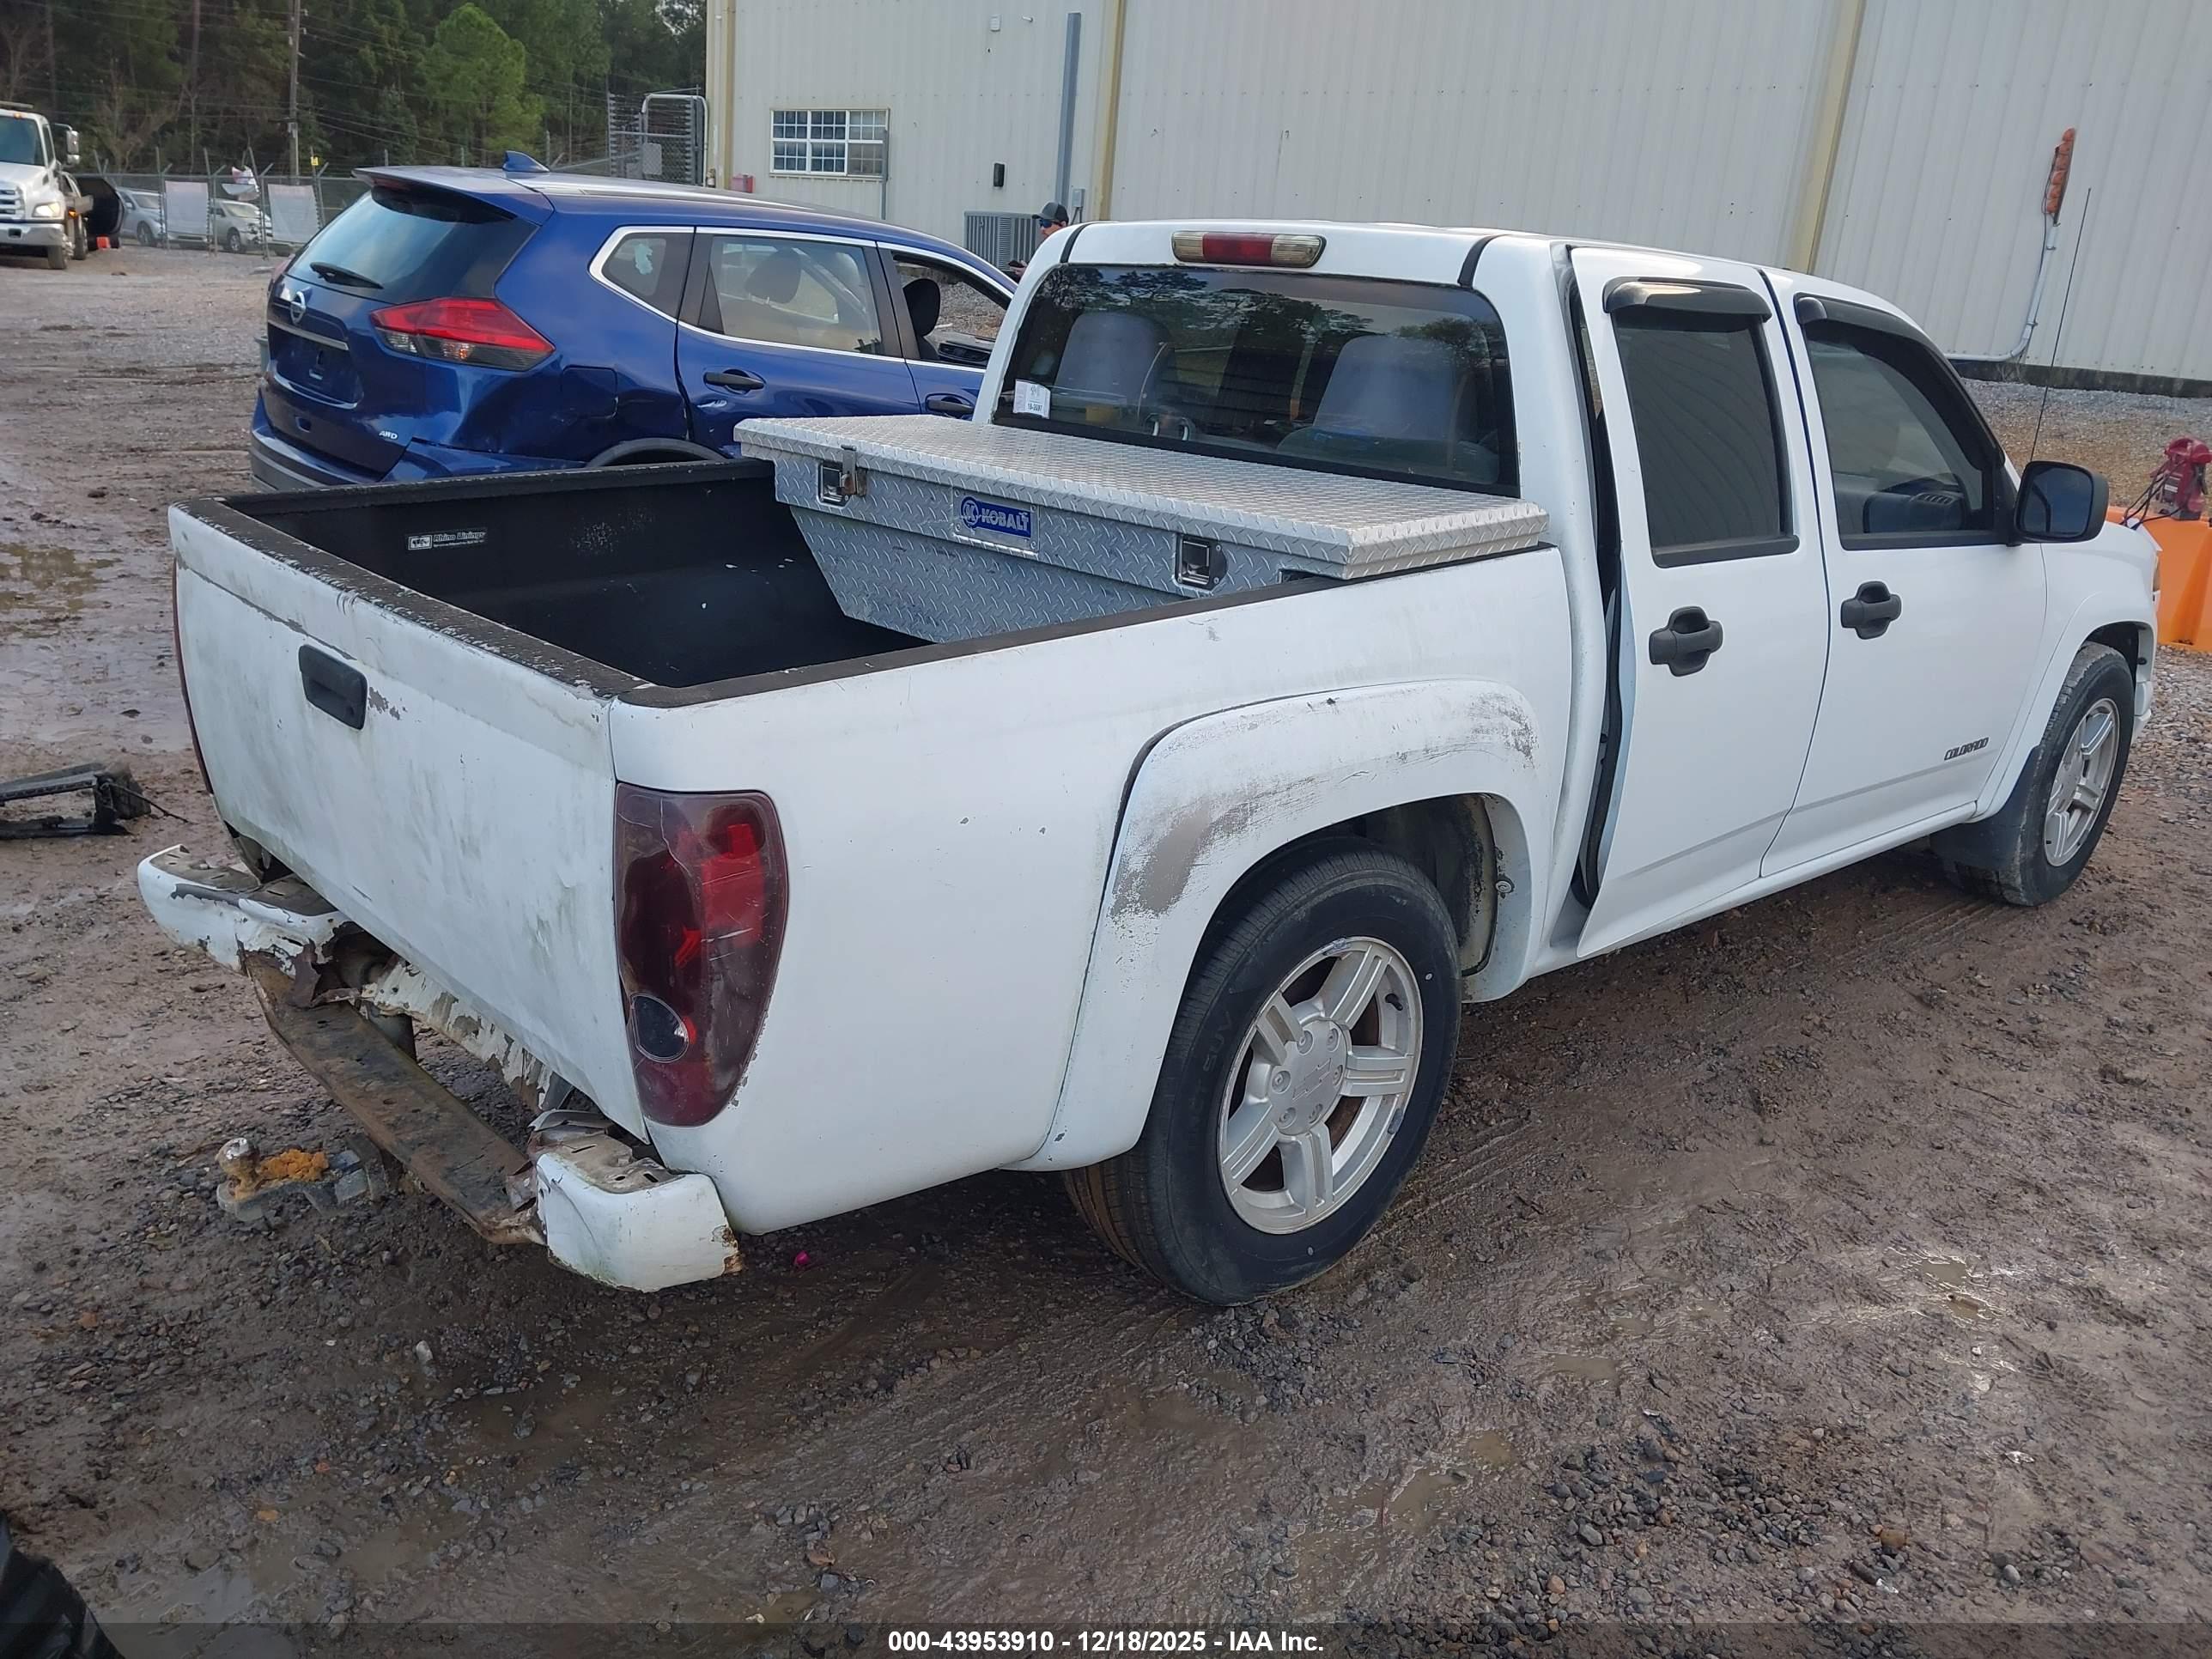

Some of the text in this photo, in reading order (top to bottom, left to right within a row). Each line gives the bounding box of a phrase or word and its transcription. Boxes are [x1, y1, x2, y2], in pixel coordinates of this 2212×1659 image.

[378, 430, 398, 439] AWD
[981, 507, 1029, 532] KOBALT
[433, 531, 486, 543] Rhino Linings
[1944, 737, 1989, 761] COLORADO
